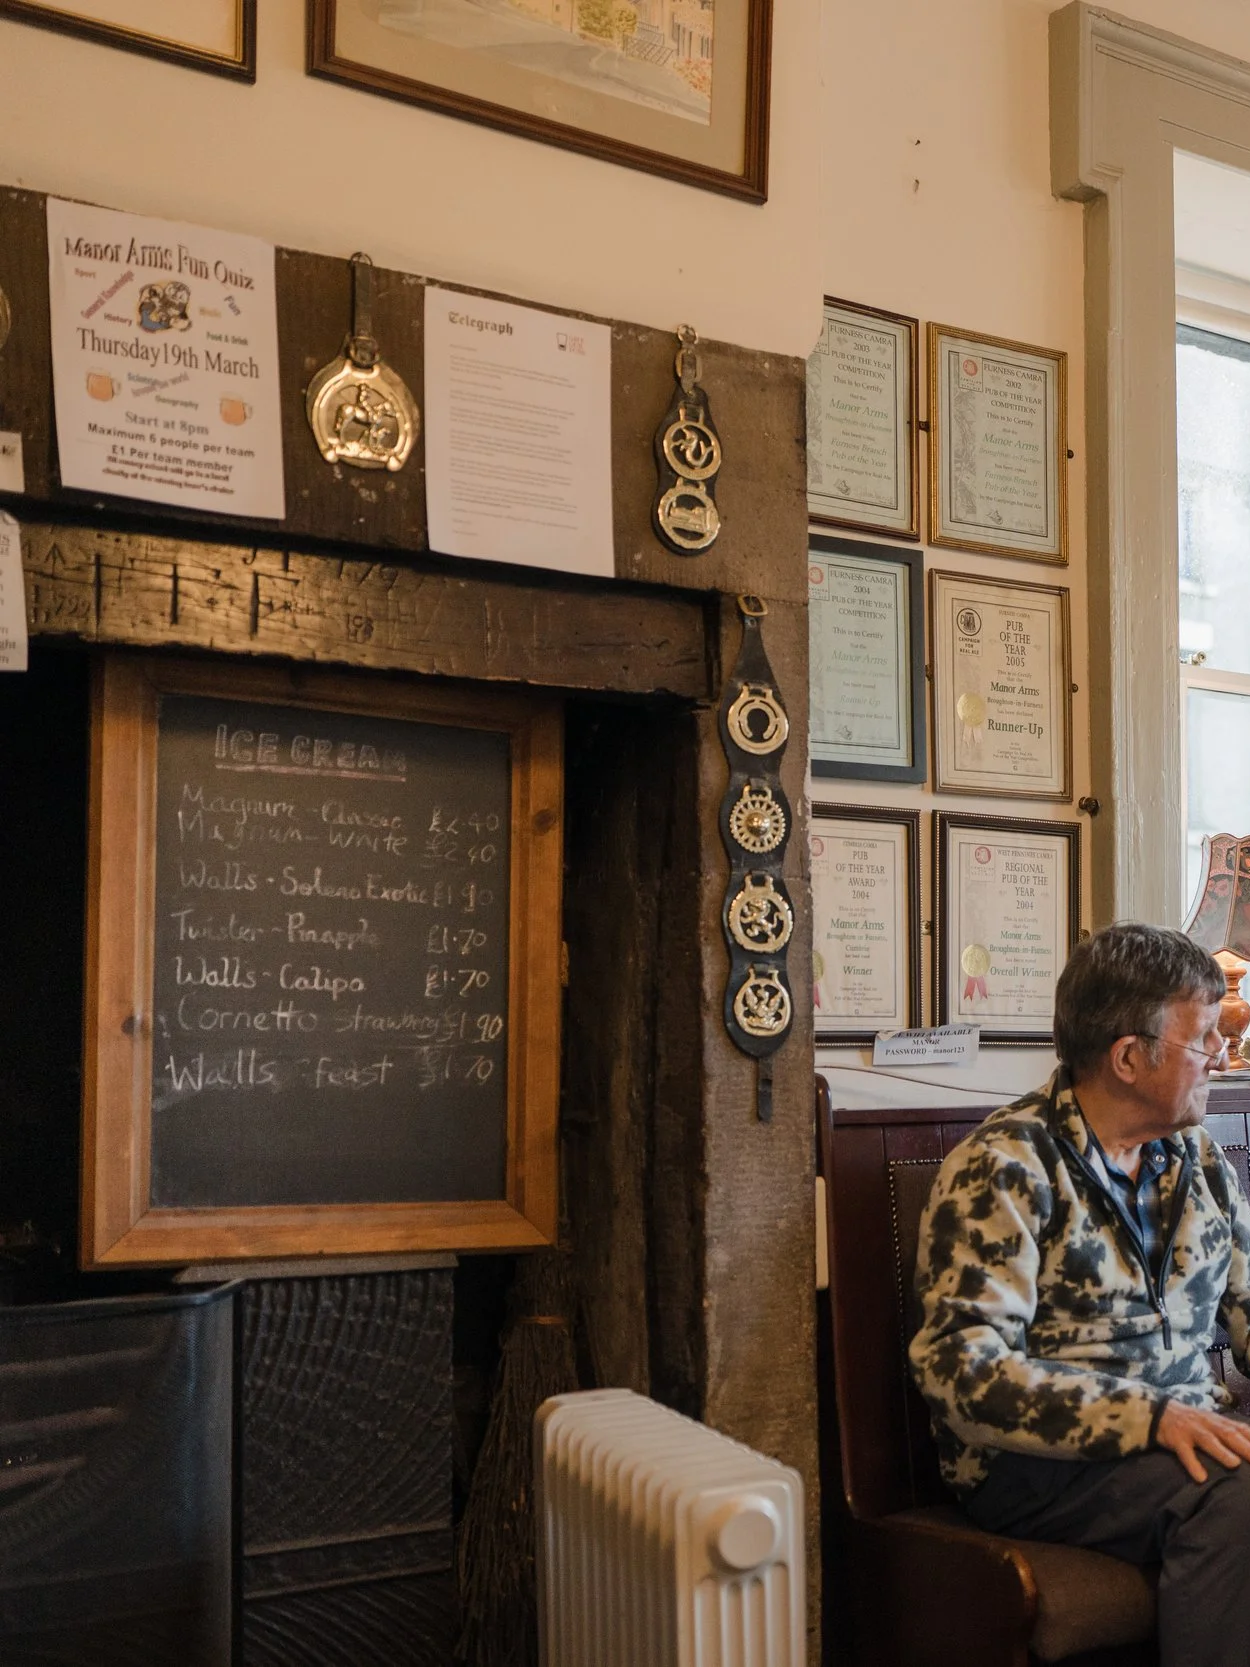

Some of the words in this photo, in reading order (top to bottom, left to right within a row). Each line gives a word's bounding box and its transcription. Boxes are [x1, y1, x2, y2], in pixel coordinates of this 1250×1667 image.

[64, 237, 122, 263] Manor
[126, 237, 173, 271] Arms
[177, 244, 209, 280] Fun
[213, 260, 255, 291] Quiz
[74, 267, 97, 279] Sport
[224, 294, 241, 316] Fun
[104, 312, 133, 327] History
[448, 311, 513, 336] Telegraph
[830, 324, 862, 339] FURNESS
[864, 333, 892, 346] CAMRA
[76, 327, 161, 367] Thursday
[163, 342, 199, 369] 19th
[205, 350, 260, 379] March
[853, 343, 870, 353] 2003
[831, 350, 846, 359] PUB
[858, 357, 872, 366] THE
[873, 360, 892, 370] YEAR
[837, 364, 886, 380] COMPETITION
[983, 363, 1015, 377] FURNESS
[1016, 371, 1043, 382] CAMRA
[861, 383, 882, 393] Certify
[1006, 379, 1022, 389] 2002
[985, 387, 998, 396] PUB
[1010, 393, 1023, 401] THE
[1024, 396, 1042, 405] YEAR
[829, 398, 861, 413] Manor
[862, 406, 889, 419] Arms
[991, 400, 1036, 414] COMPETITION
[125, 411, 159, 428] Start
[163, 417, 175, 430] at
[180, 420, 209, 436] 8pm
[87, 422, 145, 442] Maximum
[149, 433, 156, 443] 6
[160, 436, 200, 450] people
[203, 443, 222, 454] per
[225, 446, 255, 458] team
[983, 433, 1013, 447] Manor
[1014, 440, 1039, 452] Arms
[130, 447, 149, 460] Per
[153, 453, 183, 466] team
[186, 458, 233, 473] member
[830, 570, 863, 581] FURNESS
[865, 575, 893, 586] CAMRA
[853, 585, 870, 595] 2004
[831, 595, 846, 604] PUB
[859, 599, 872, 607] THE
[874, 601, 893, 609] YEAR
[838, 608, 887, 620] COMPETITION
[833, 626, 846, 635] This
[862, 630, 883, 639] Certify
[1006, 620, 1024, 631] PUB
[1000, 631, 1012, 642] OF
[1013, 633, 1031, 644] THE
[1004, 643, 1026, 655] YEAR
[831, 649, 860, 662] Manor
[862, 654, 888, 665] Arms
[1006, 656, 1025, 667] 2005
[990, 681, 1016, 693] Manor
[1018, 686, 1040, 696] Arms
[987, 719, 1043, 739] Runner-Up
[214, 723, 279, 764] ICE
[291, 735, 407, 772] CREAM
[852, 851, 868, 860] PUB
[836, 863, 847, 872] OF
[848, 864, 864, 873] THE
[866, 865, 885, 874] YEAR
[1005, 862, 1045, 874] REGIONAL
[180, 861, 258, 890] Walls
[848, 877, 876, 887] AWARD
[1002, 874, 1018, 884] PUB
[1020, 875, 1031, 885] OF
[1032, 876, 1048, 886] THE
[852, 890, 870, 900] 2004
[1015, 886, 1035, 897] YEAR
[1016, 900, 1034, 910] 2004
[830, 918, 859, 929] Manor
[861, 920, 885, 930] Arms
[1000, 931, 1022, 940] Manor
[1024, 932, 1041, 941] Arms
[174, 955, 258, 989] Walls
[843, 966, 873, 975] Winner
[990, 966, 1019, 977] Overall
[1022, 967, 1053, 978] Winner
[177, 991, 318, 1032] Cornetto
[926, 1028, 973, 1038] AVAILABLE
[885, 1048, 927, 1056] PASSWORD
[933, 1046, 965, 1054] manor123
[165, 1049, 277, 1091] Walls
[315, 1054, 393, 1089] Feast
